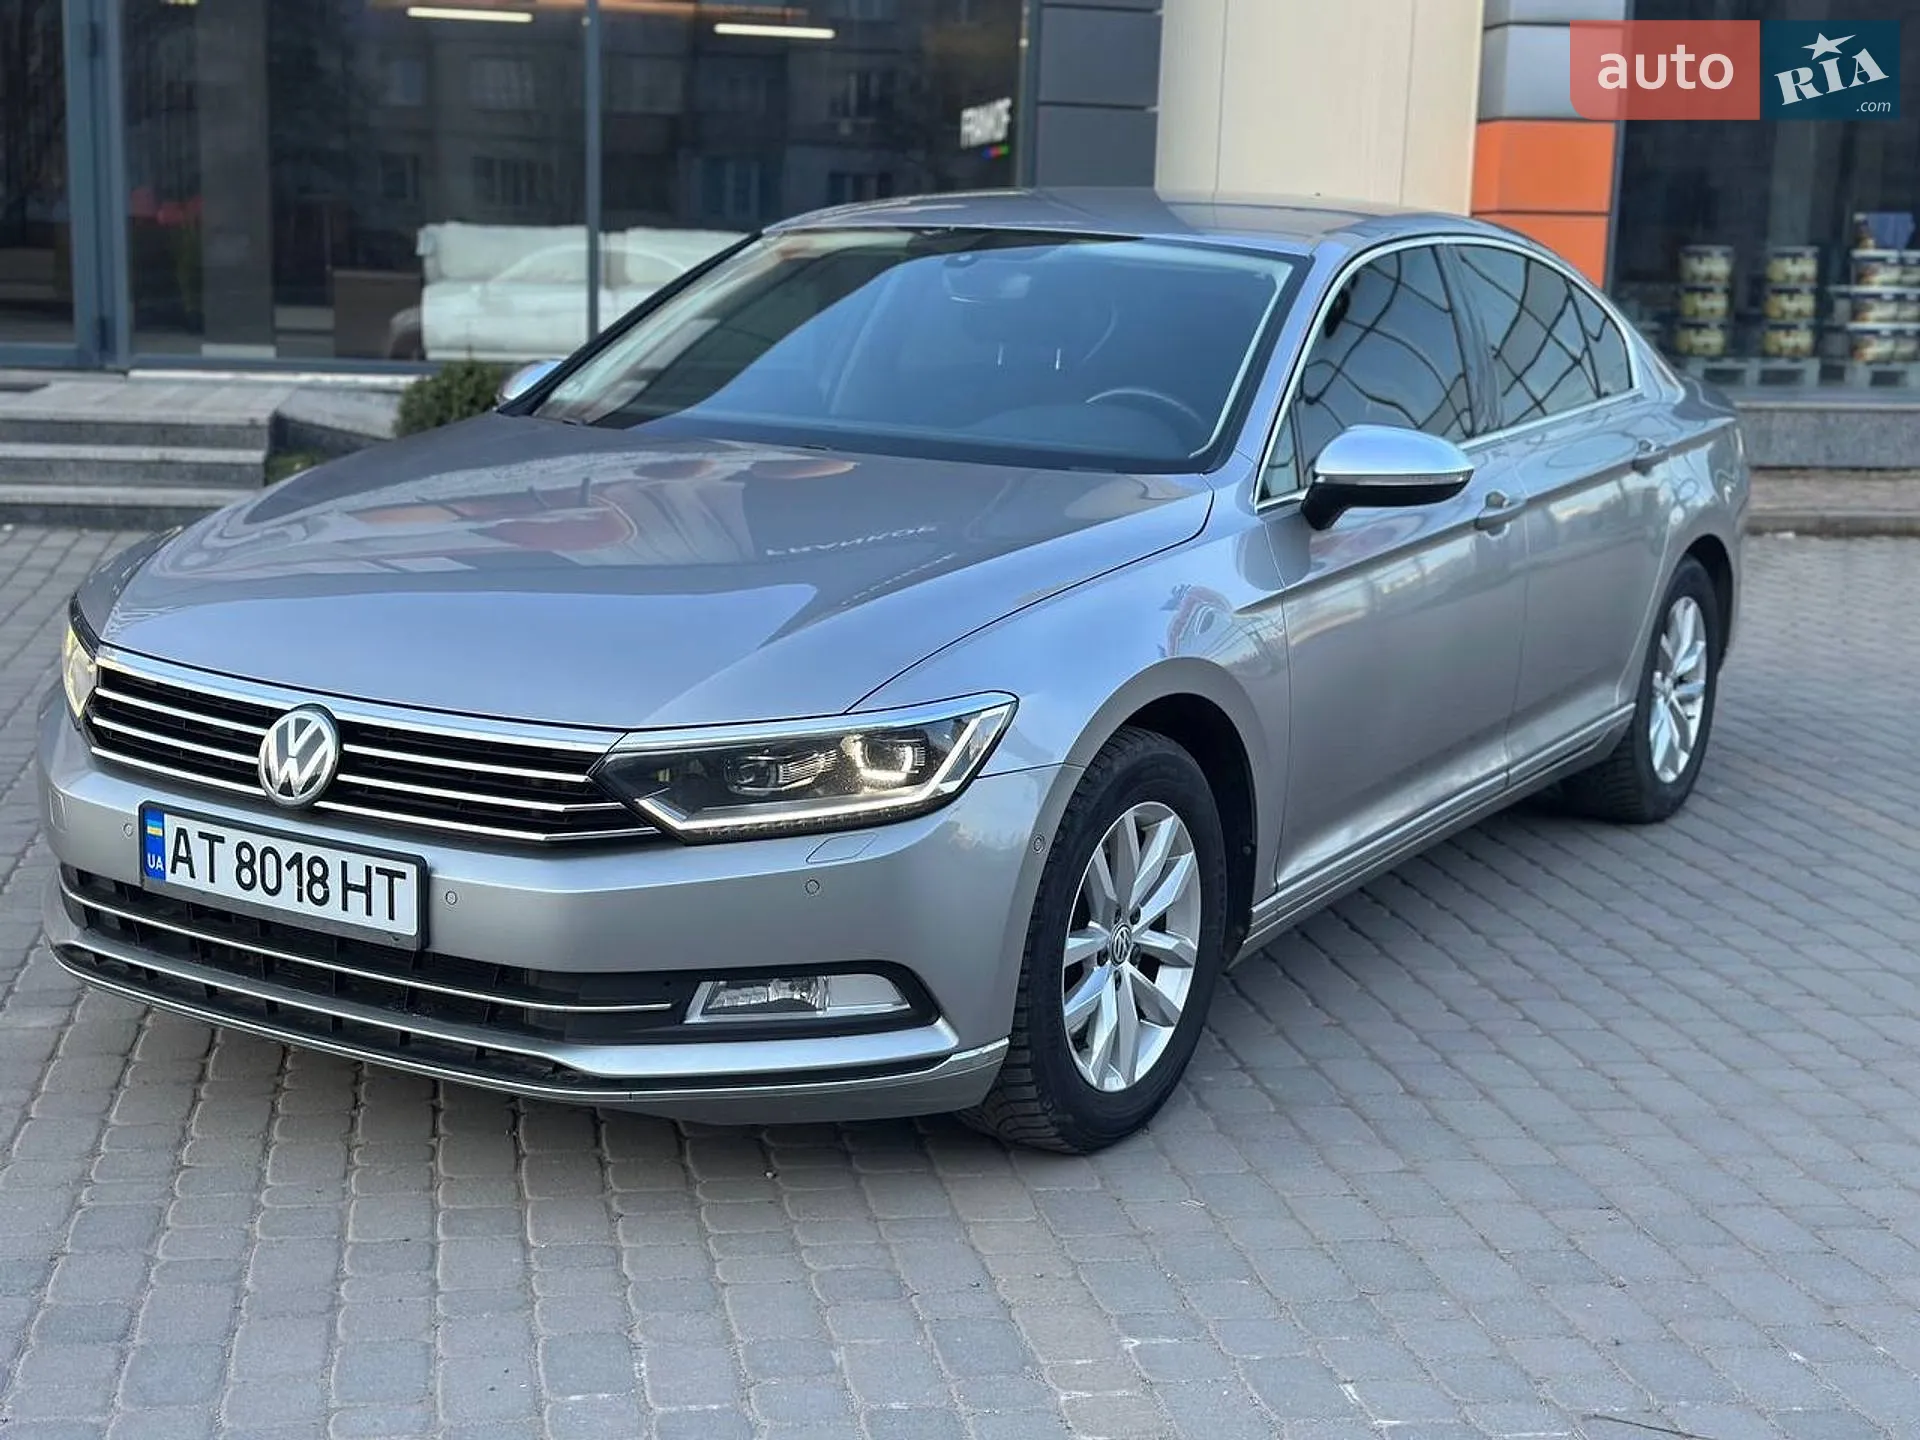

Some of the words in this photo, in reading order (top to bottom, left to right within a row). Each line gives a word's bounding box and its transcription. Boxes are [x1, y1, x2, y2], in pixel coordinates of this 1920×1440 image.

[147, 853, 165, 871] UA
[170, 826, 225, 884] AT
[235, 841, 330, 906] 8018
[341, 860, 406, 921] HT
